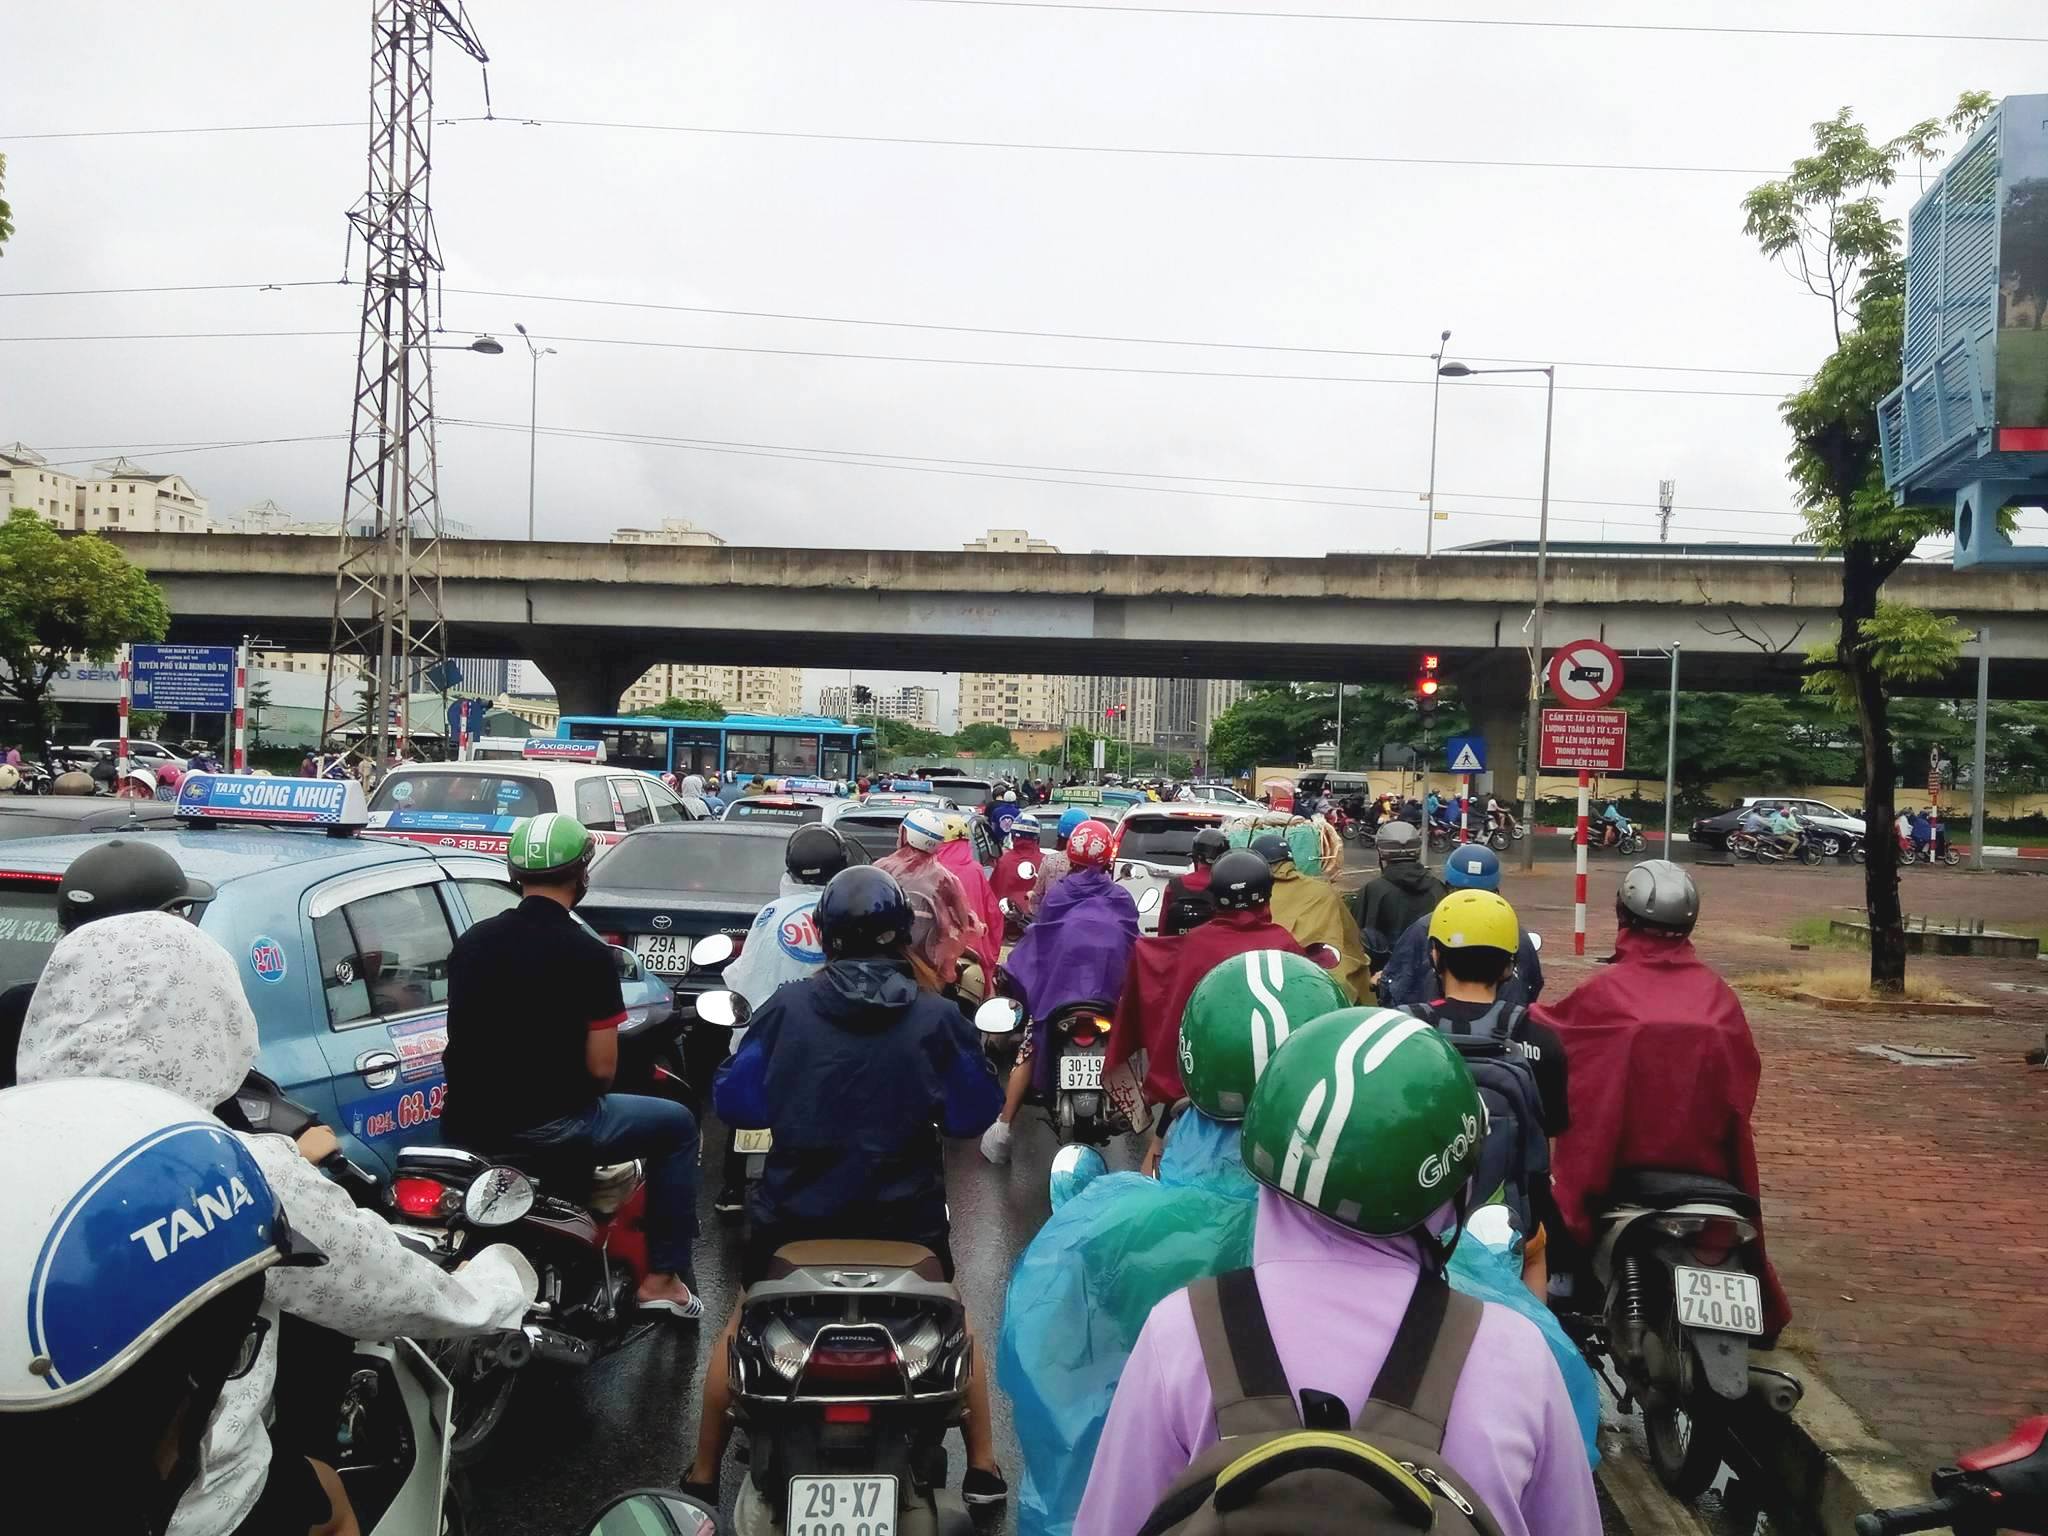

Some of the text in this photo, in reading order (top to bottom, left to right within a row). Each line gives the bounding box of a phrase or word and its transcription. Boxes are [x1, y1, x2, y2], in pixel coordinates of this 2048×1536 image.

[1565, 714, 1573, 722] XE
[534, 743, 596, 751] TAXIGROUP
[215, 781, 344, 812] TAXI SÔNG NHUỆ
[458, 839, 508, 851] 38.57.5
[253, 945, 284, 973] 271
[649, 936, 676, 953] 29A
[1068, 1059, 1102, 1072] 30-L9
[1418, 1112, 1477, 1188] Grab
[130, 1176, 255, 1263] TANA
[1688, 1272, 1746, 1302] 29-E1
[1683, 1297, 1757, 1330] 740.08
[805, 1482, 881, 1518] 29-X7
